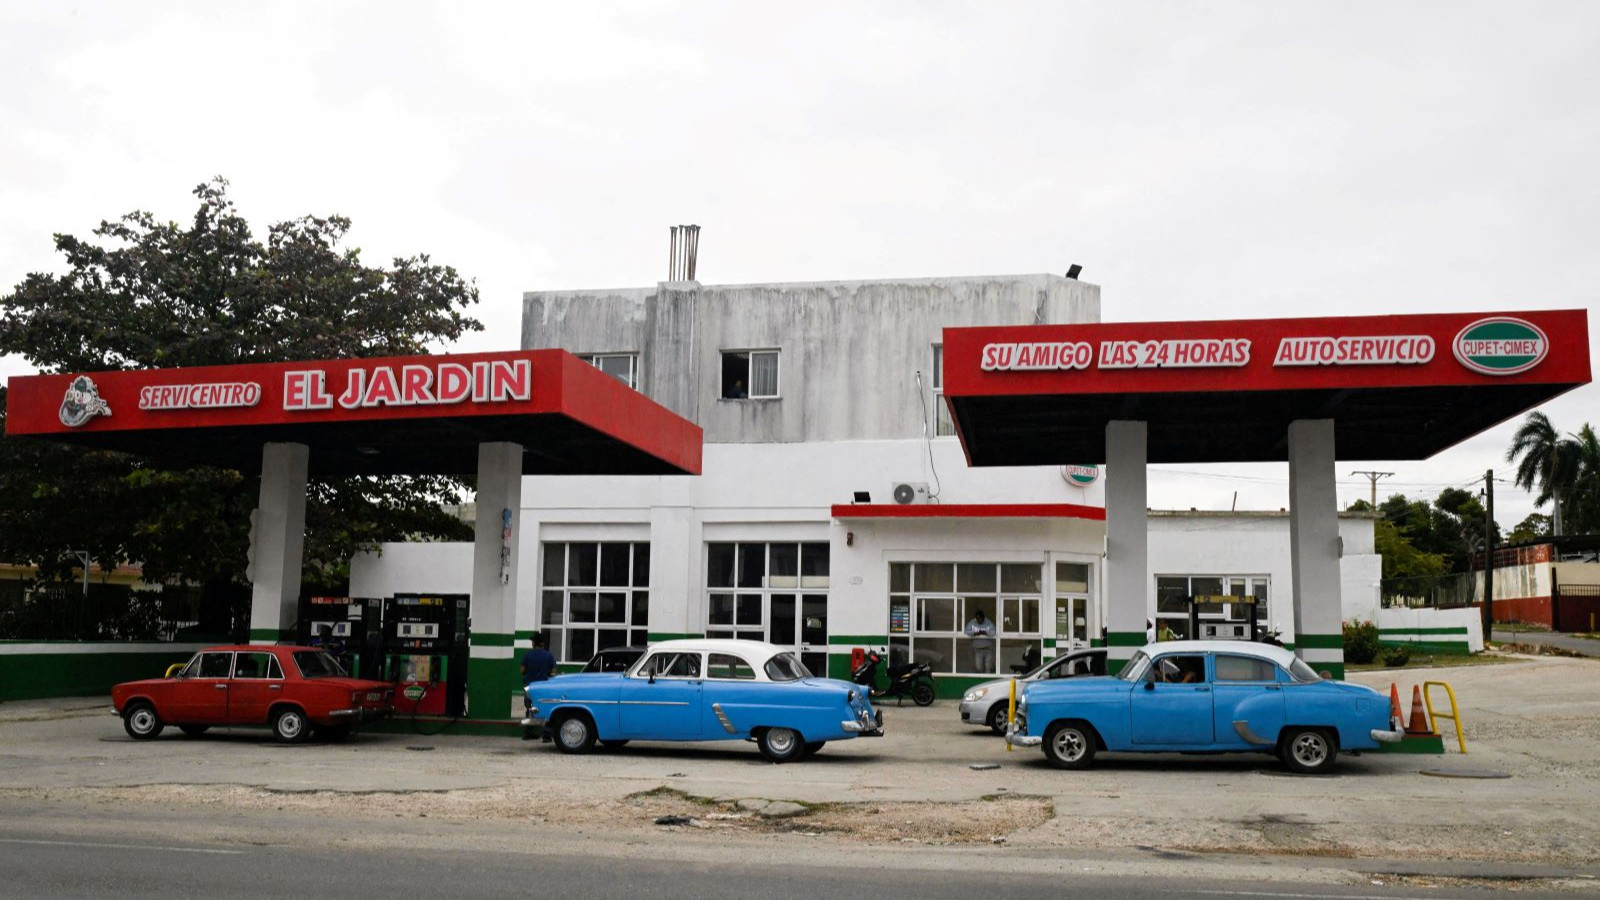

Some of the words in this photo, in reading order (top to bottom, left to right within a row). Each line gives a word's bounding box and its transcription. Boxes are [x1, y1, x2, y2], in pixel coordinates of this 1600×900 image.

[984, 345, 1014, 368] SU
[1016, 343, 1091, 367] AMIGO
[1100, 343, 1138, 366] LAS
[1143, 341, 1169, 365] 24
[1174, 340, 1248, 364] HORAS
[139, 382, 258, 408] SERVICENTRO
[284, 371, 332, 409] EL
[339, 361, 530, 409] JARDIN
